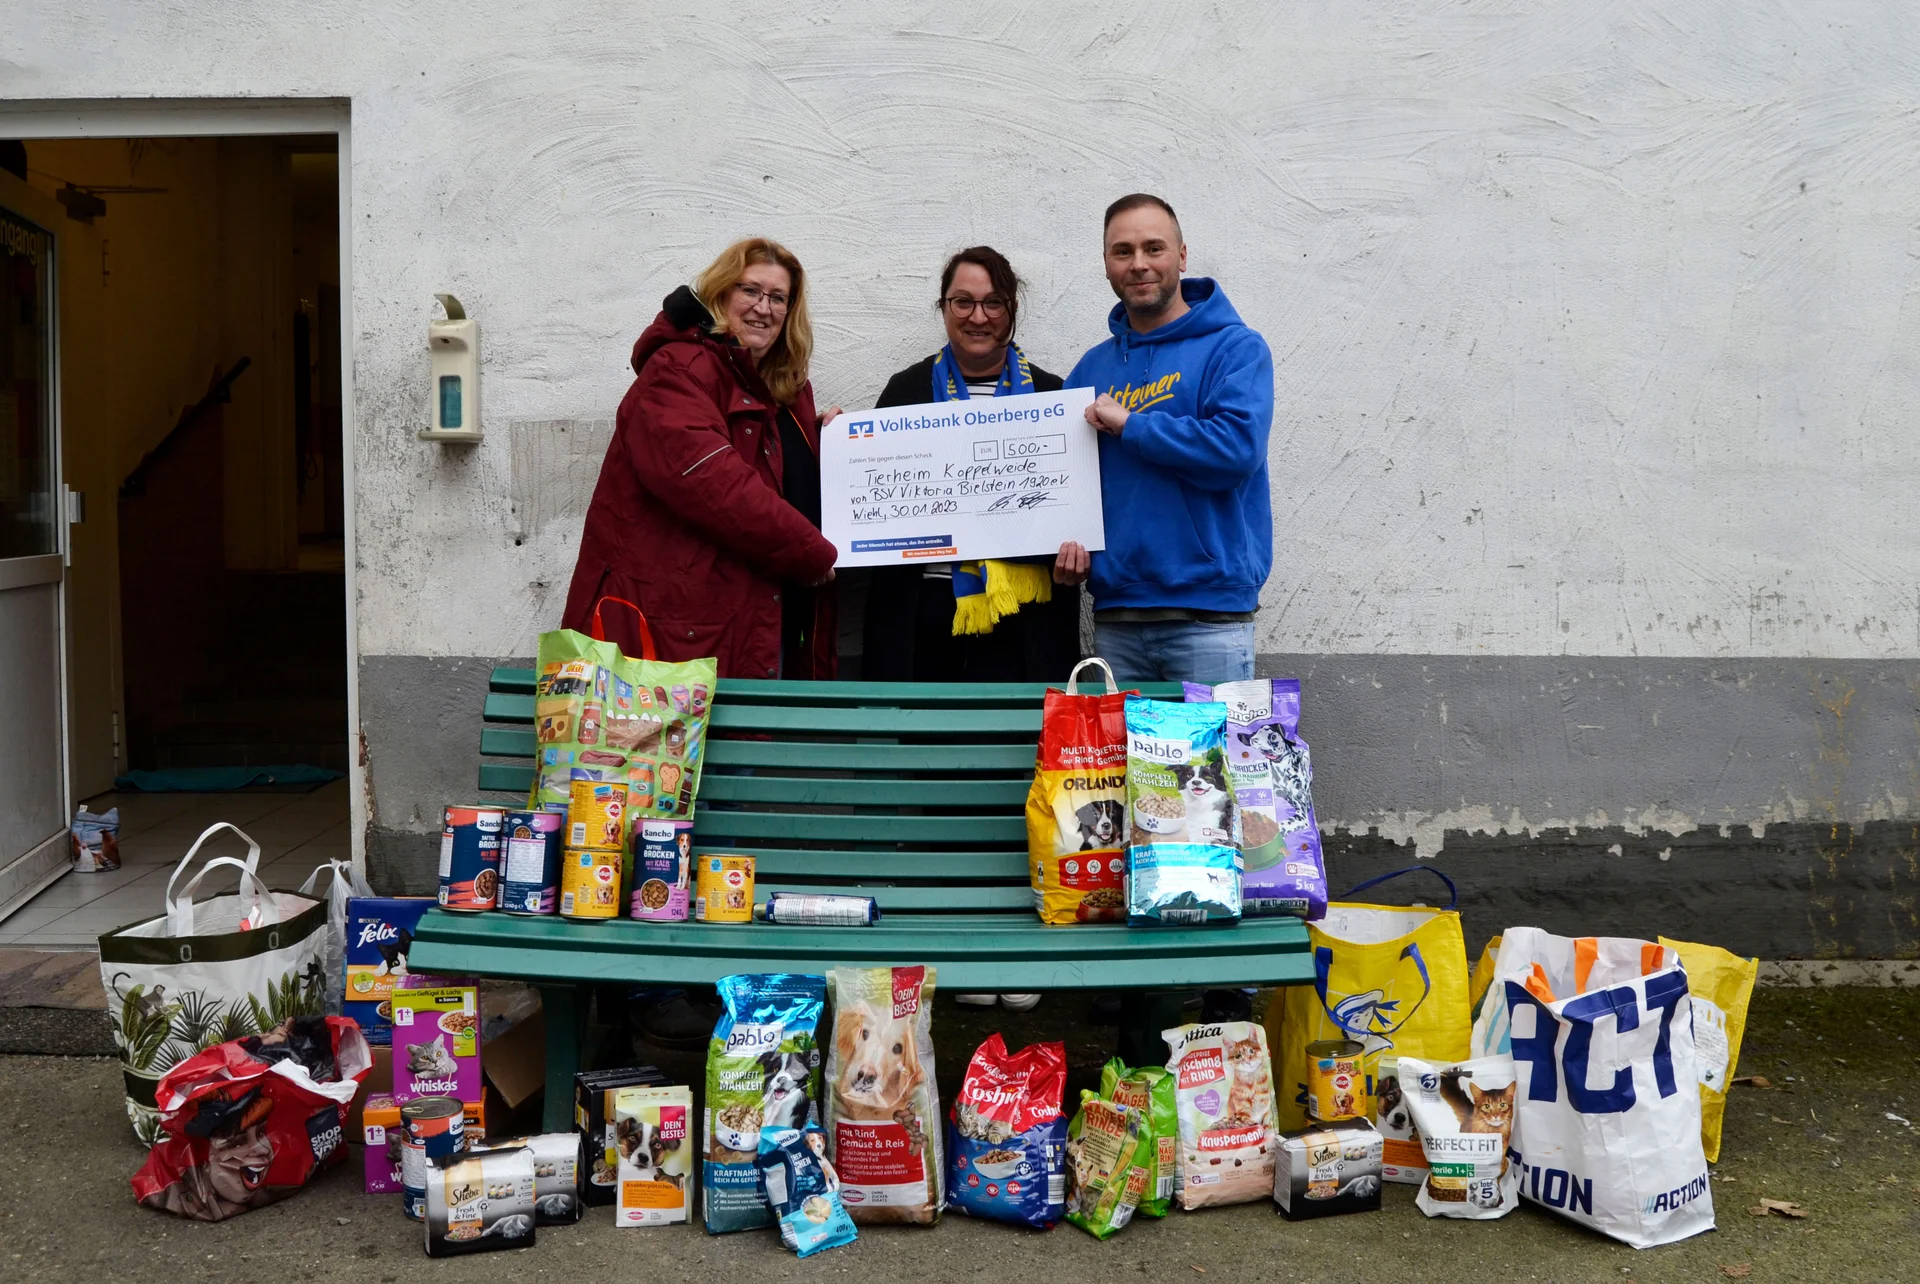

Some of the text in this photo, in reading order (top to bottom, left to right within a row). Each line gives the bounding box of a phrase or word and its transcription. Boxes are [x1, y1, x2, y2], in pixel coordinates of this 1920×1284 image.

[879, 403, 1065, 432] Volksbank Oberberg eG
[864, 468, 931, 487] Tierheim
[850, 495, 867, 505] von
[869, 486, 898, 502] BSV
[901, 483, 953, 499] Viktoria
[957, 479, 1016, 496] Bielstein
[852, 506, 887, 522] Wiehl,
[1061, 746, 1086, 755] MULTI
[1133, 739, 1183, 759] pablo
[1075, 755, 1094, 764] Rind
[1133, 777, 1177, 788] MAHLZEIT
[644, 829, 672, 838] Sancho
[643, 850, 675, 859] BROCKEN
[1296, 879, 1315, 892] 5 kg
[356, 923, 398, 948] felix
[727, 1028, 775, 1051] pablo
[720, 1070, 759, 1080] KOMPLETT
[1190, 1069, 1216, 1083] RIND
[409, 1080, 458, 1093] whiskas
[719, 1081, 763, 1091] MAHLZEIT
[1084, 1103, 1126, 1127] NAGER
[664, 1122, 682, 1130] DEIN
[1086, 1110, 1124, 1138] RINGE
[311, 1125, 341, 1147] SHOP
[660, 1129, 685, 1139] BESTES
[840, 1128, 878, 1139] mit Rind,
[840, 1138, 905, 1148] Gemüse & Reis
[1425, 1137, 1475, 1151] PERFECT
[1311, 1147, 1338, 1167] Sheba
[1455, 1166, 1466, 1175] 1+
[450, 1184, 480, 1206] Sheba
[1481, 1187, 1494, 1200] 5
[1653, 1173, 1706, 1214] ACTION
